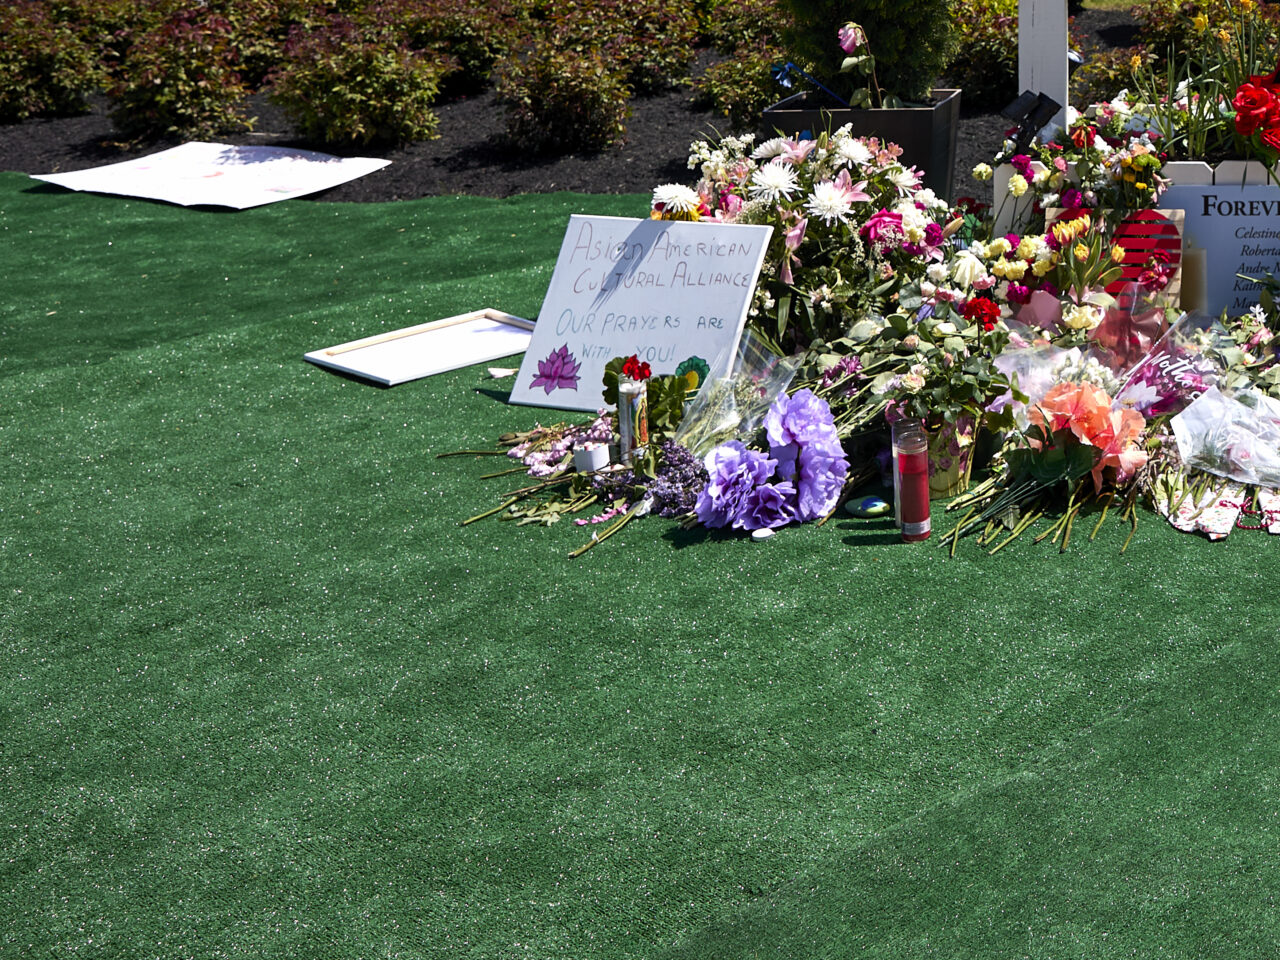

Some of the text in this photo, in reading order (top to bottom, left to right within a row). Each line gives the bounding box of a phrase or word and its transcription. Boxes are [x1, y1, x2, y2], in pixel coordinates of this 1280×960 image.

[671, 261, 750, 288] ALLIANCE
[1236, 262, 1270, 274] Andre
[556, 308, 596, 336] OUR
[697, 316, 724, 329] ARE
[636, 344, 675, 362] YOU!
